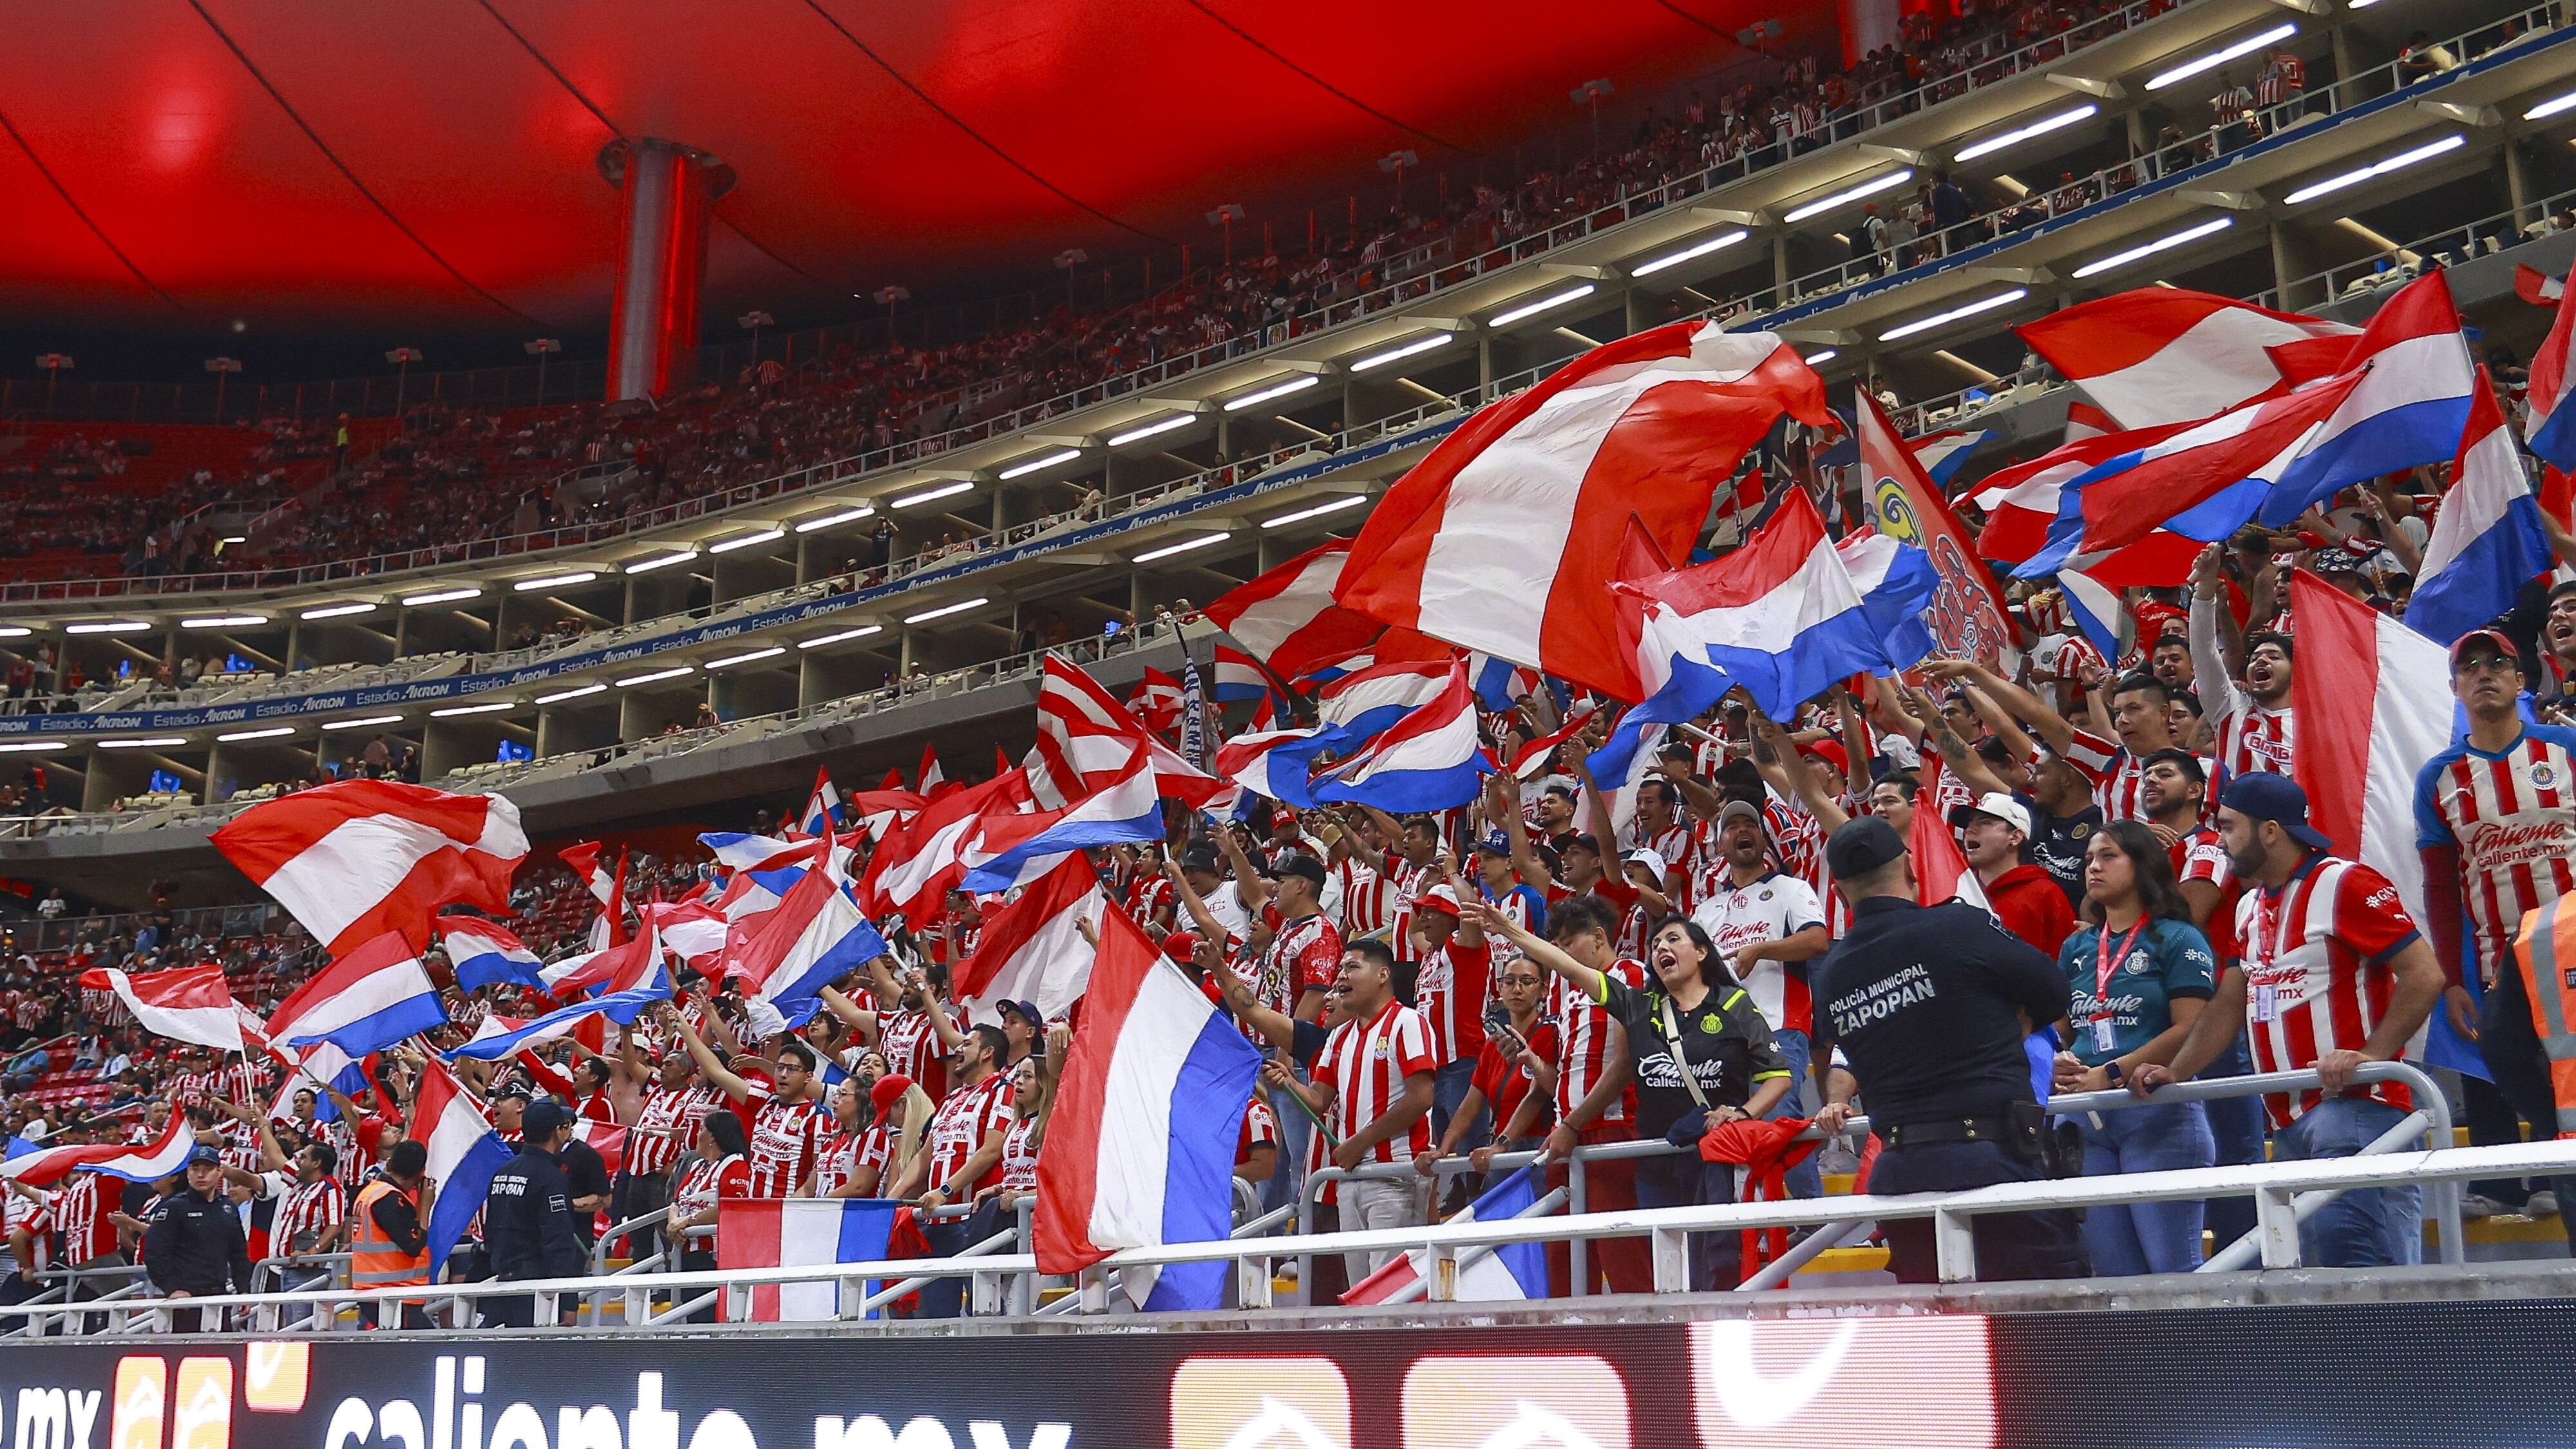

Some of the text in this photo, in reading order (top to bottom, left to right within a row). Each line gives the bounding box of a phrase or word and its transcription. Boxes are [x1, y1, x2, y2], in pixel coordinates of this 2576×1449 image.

[752, 612, 795, 630] Estadio
[652, 636, 694, 654] Estadio
[559, 658, 598, 674] Estadio
[460, 668, 549, 694] Estadio AKRON
[357, 684, 450, 706] Estadio AKRON
[153, 708, 247, 726] Estadio AKRON
[256, 697, 345, 717] Estadio AKRON
[0, 720, 28, 733] RON
[41, 715, 141, 732] Estadio AKRON
[2249, 735, 2293, 760] BIMB
[2467, 820, 2565, 857] Caliente
[2477, 844, 2566, 867] caliente.mx
[1732, 895, 1748, 909] MG
[1830, 963, 1928, 1016] POLICÍA MUNICIPAL
[1833, 978, 1935, 1037] ZAPOPAN
